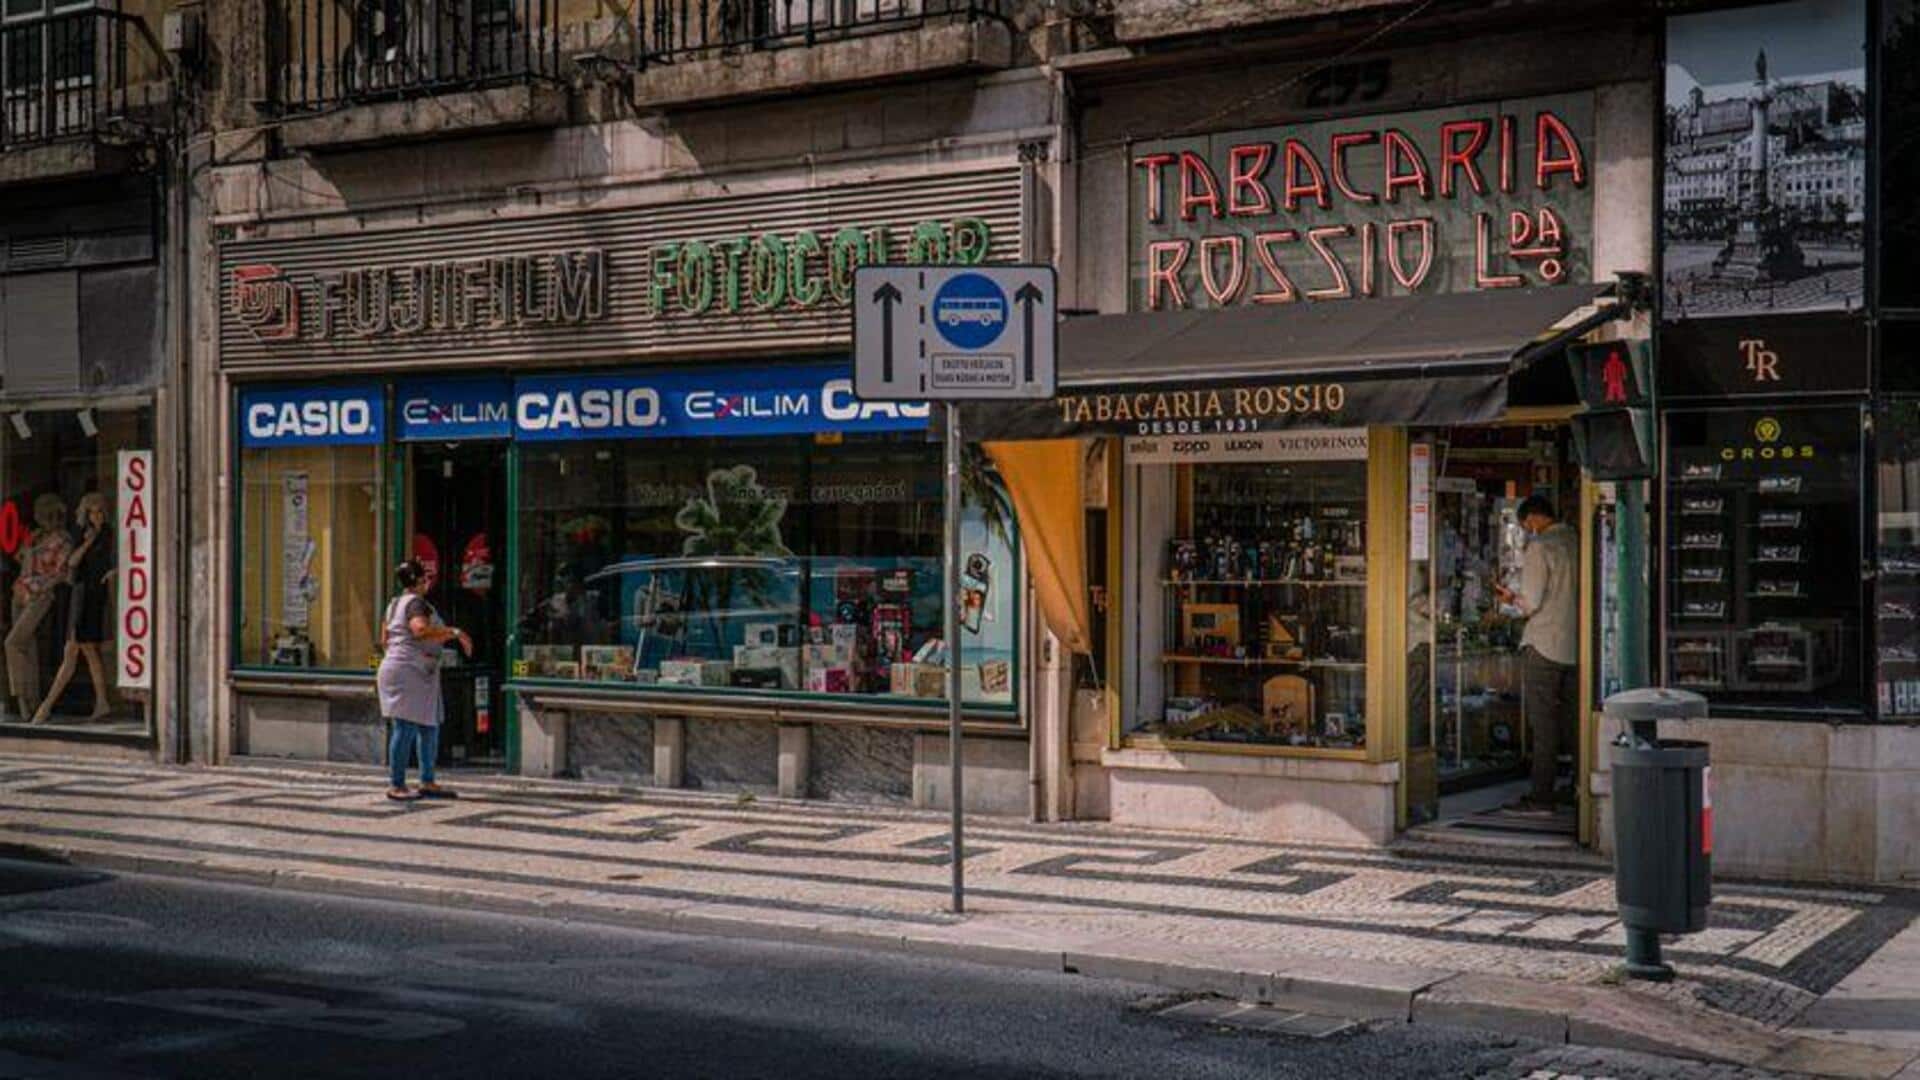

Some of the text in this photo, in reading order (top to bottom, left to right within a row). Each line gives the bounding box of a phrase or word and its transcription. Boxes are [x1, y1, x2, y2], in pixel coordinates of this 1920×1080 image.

[1134, 111, 1586, 222] TABACARIA
[1148, 218, 1435, 309] ROSSIO
[314, 248, 609, 338] FUJIFILM
[248, 399, 371, 438] CASIO
[403, 398, 508, 424] EXILIM
[516, 387, 659, 430] CASIO
[685, 389, 809, 419] EXILIM
[1059, 384, 1344, 422] TABACARIA ROSSIO
[1139, 418, 1258, 435] DESDE 1931
[1721, 445, 1815, 459] CROSS
[125, 457, 149, 678] SALDOS
